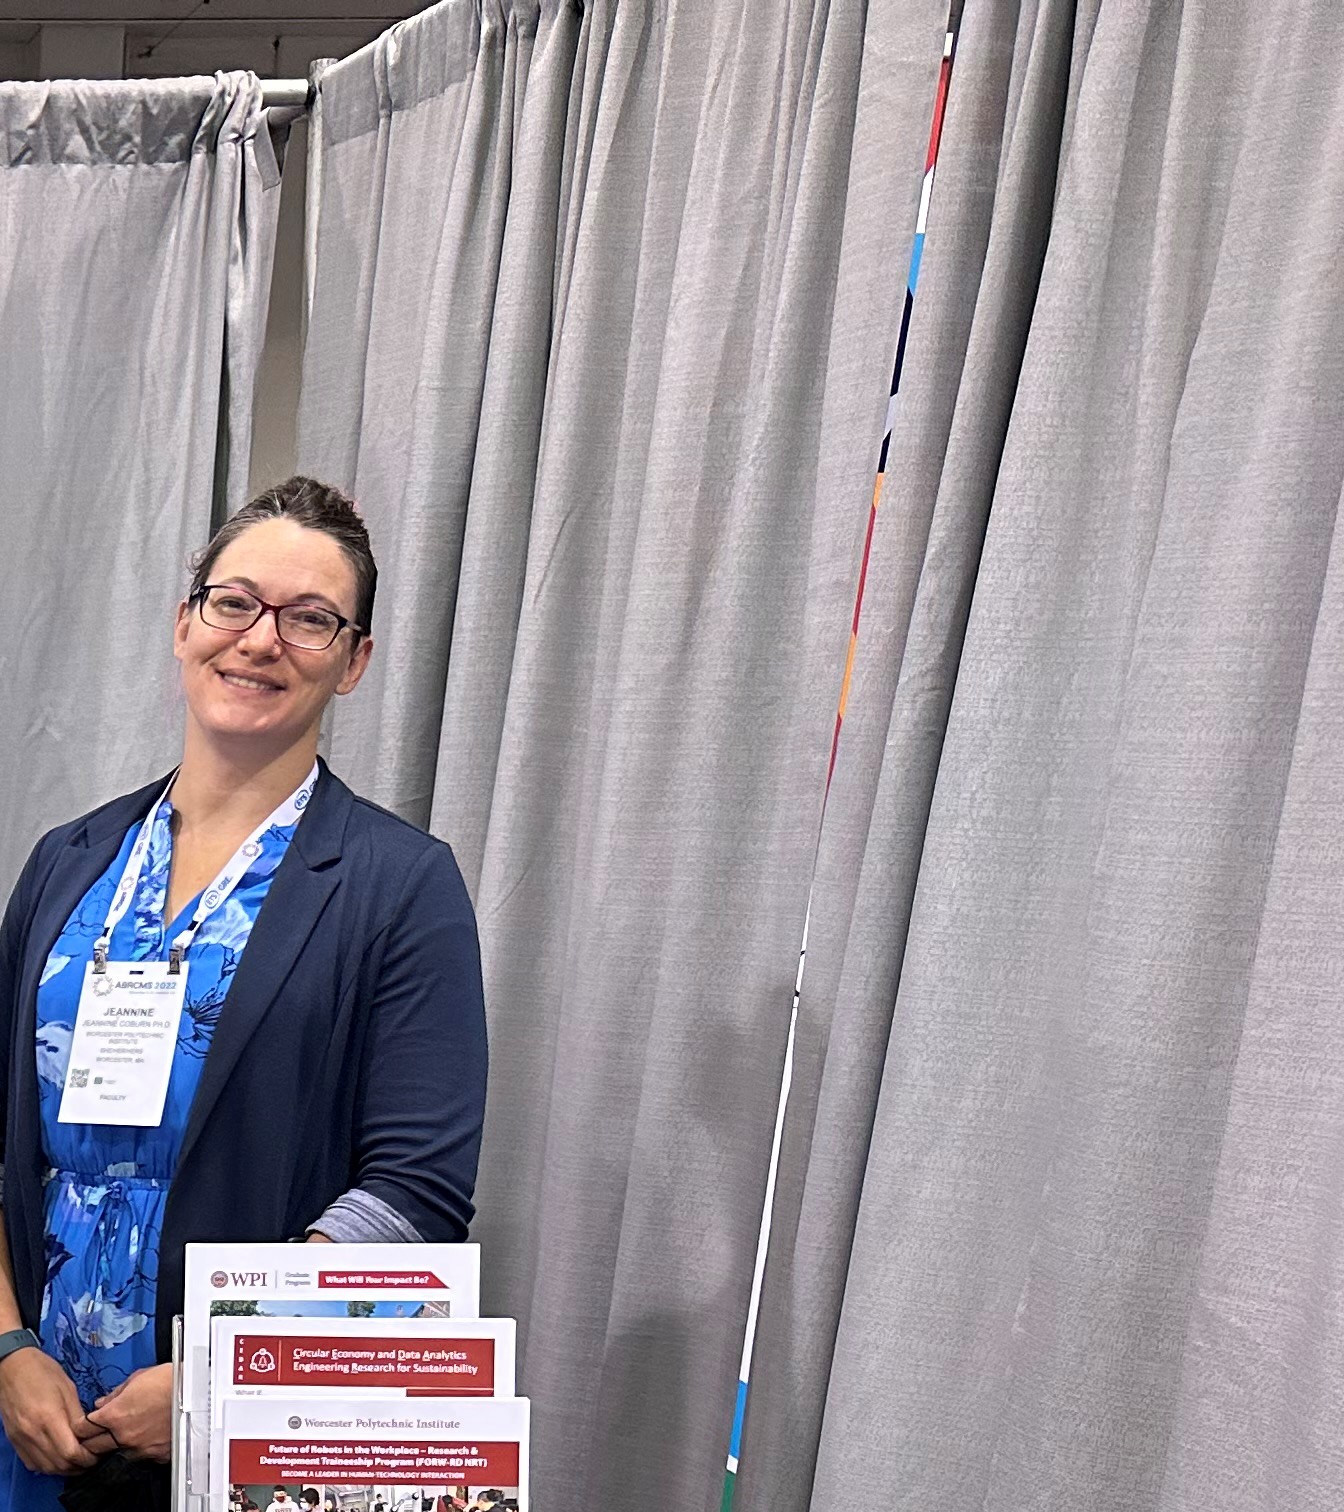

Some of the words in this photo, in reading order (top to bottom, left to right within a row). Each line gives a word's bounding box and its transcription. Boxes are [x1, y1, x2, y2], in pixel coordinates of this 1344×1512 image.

[154, 981, 178, 990] 2022
[102, 1007, 156, 1017] JEANNINE
[231, 1272, 268, 1287] WPI
[325, 1275, 347, 1285] What
[348, 1275, 364, 1285] Will
[365, 1275, 384, 1285] Your
[384, 1275, 413, 1286] Impact
[413, 1275, 430, 1285] Be?
[292, 1348, 330, 1360] Circular
[331, 1349, 375, 1361] Economy
[377, 1349, 396, 1360] and
[397, 1349, 421, 1361] Data
[422, 1350, 467, 1362] Analytics
[293, 1361, 350, 1374] Engineering
[351, 1362, 395, 1374] Research
[396, 1363, 411, 1373] for
[412, 1364, 479, 1376] Sustainability
[304, 1417, 353, 1428] Worcester
[356, 1418, 414, 1430] Polytechnic
[416, 1420, 461, 1429] Institute
[268, 1444, 298, 1455] Future
[299, 1445, 310, 1455] of
[310, 1445, 343, 1455] Robots
[343, 1445, 353, 1455] in
[354, 1445, 370, 1455] the
[370, 1445, 420, 1457] Workplace
[427, 1446, 470, 1456] Research
[470, 1447, 479, 1456] &
[259, 1456, 320, 1467] Development
[321, 1456, 373, 1468] Traineeship
[374, 1457, 415, 1469] Program
